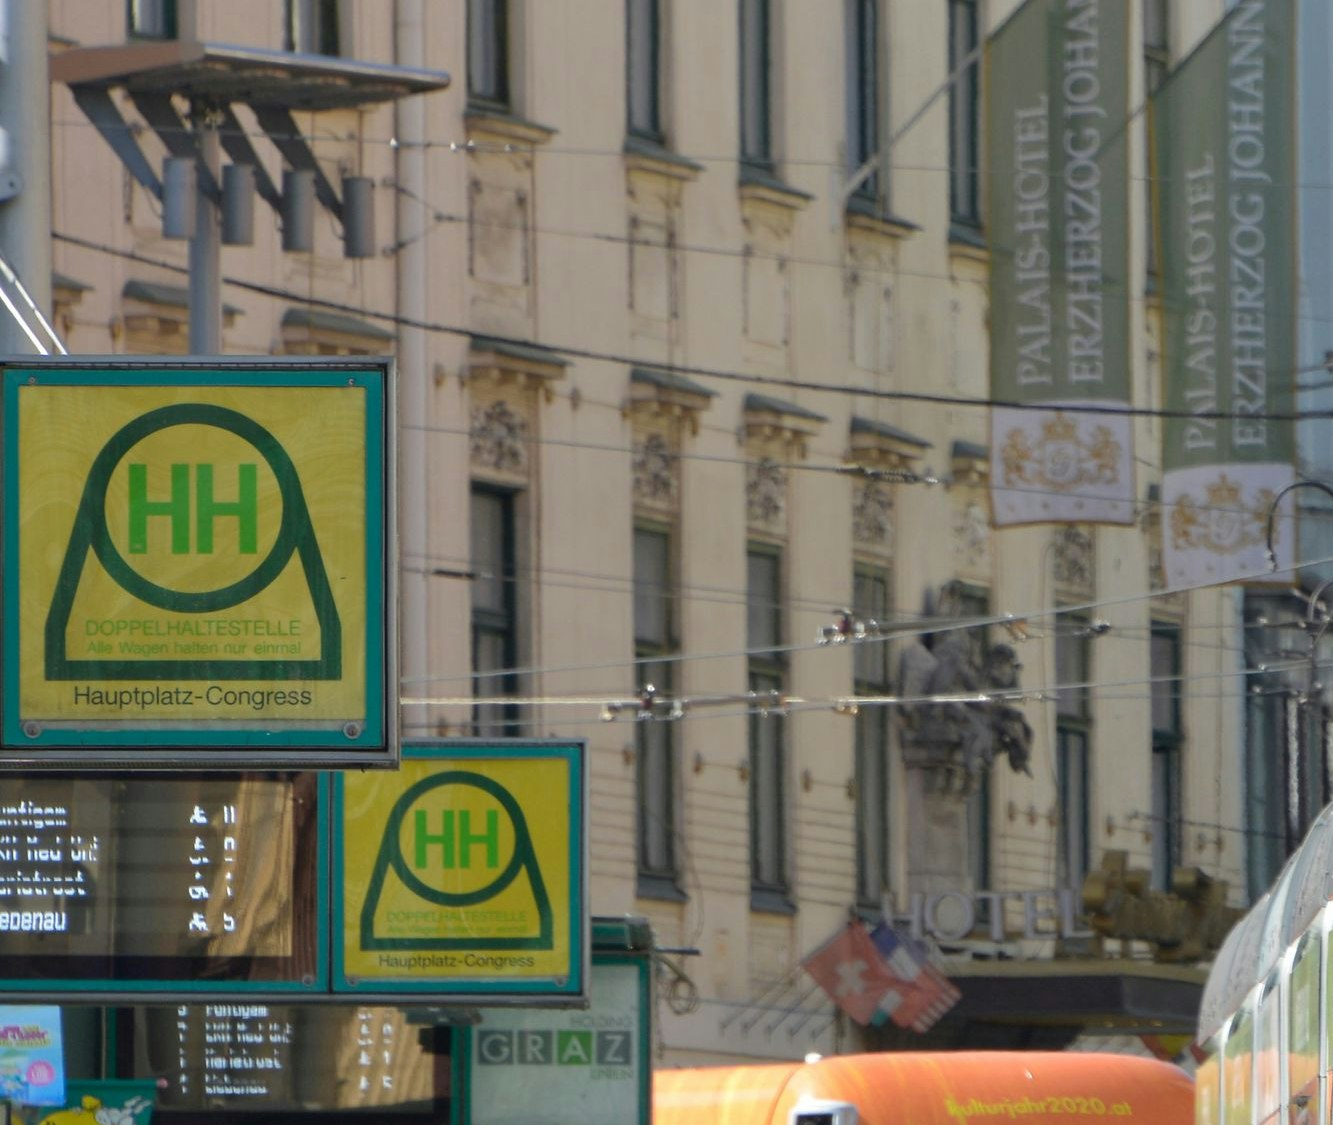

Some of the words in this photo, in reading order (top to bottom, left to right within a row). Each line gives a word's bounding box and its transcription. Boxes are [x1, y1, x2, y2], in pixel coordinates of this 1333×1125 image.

[1229, 2, 1273, 183] JOHANN
[1014, 94, 1052, 387] PALAIS-HOTEL
[1065, 128, 1103, 384] ERZHERZOG
[1184, 152, 1216, 452] PALAIS-HOTEL
[1229, 193, 1267, 448] ERZHERZOG
[128, 463, 258, 554] HH
[85, 619, 301, 637] DOPPELHALTESTELLE
[87, 640, 114, 653] Alle
[119, 641, 169, 657] Wagen
[173, 641, 218, 654] halten
[223, 643, 247, 654] nur
[254, 640, 302, 654] einmal
[74, 685, 313, 710] Hauptplatz-Congress
[415, 809, 499, 869] HH
[379, 954, 535, 969] Hauptplatz-Congress
[481, 1033, 625, 1064] GRAZ
